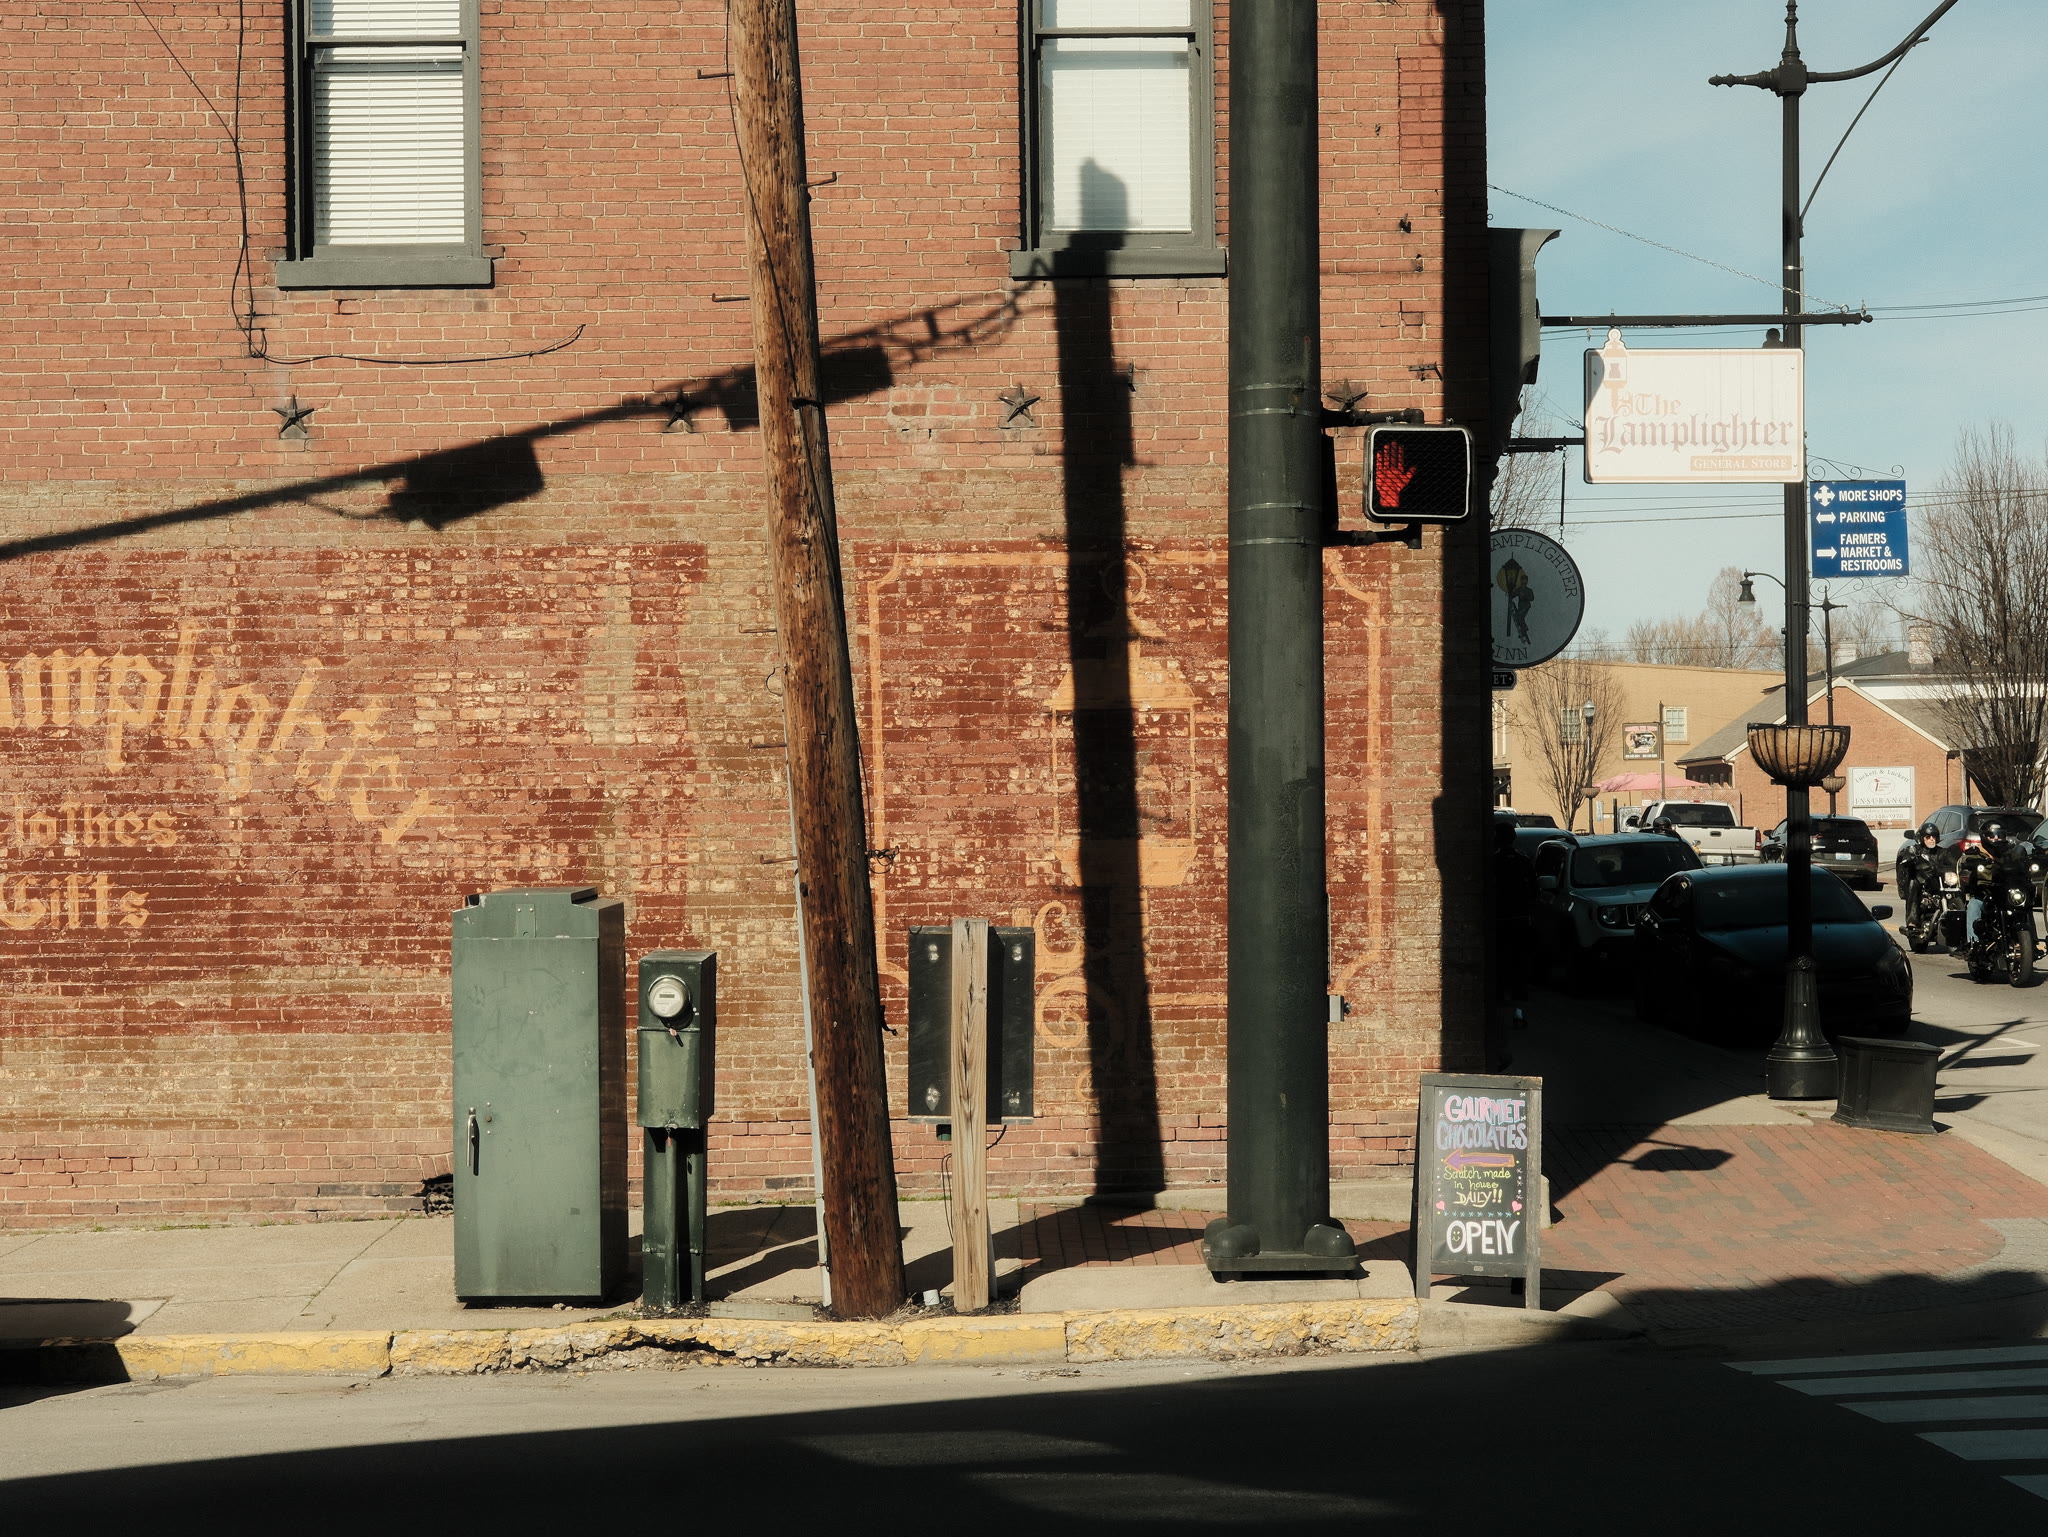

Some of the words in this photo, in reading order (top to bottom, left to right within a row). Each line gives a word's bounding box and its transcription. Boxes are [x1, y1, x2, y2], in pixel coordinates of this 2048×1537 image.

[1634, 392, 1682, 417] The
[1595, 413, 1794, 455] Lamplighter
[1751, 457, 1788, 468] STORE
[1838, 490, 1868, 502] MORE
[1869, 489, 1903, 502] SHOPS
[1839, 511, 1886, 523] PARKING
[1840, 533, 1887, 545] FARMERS
[1840, 546, 1882, 558] MARKET
[1883, 545, 1892, 557] &
[1490, 534, 1578, 599] AMPLIGHTER
[1841, 558, 1903, 572] RESTROOMS
[1494, 645, 1528, 661] INN
[0, 795, 178, 847] lothes
[1445, 1095, 1525, 1125] GOURMET
[1437, 1121, 1528, 1150] CHOCOLATES
[1484, 1168, 1511, 1179] made
[1454, 1180, 1464, 1189] in
[1469, 1179, 1499, 1189] house
[1446, 1220, 1520, 1255] OPEN
